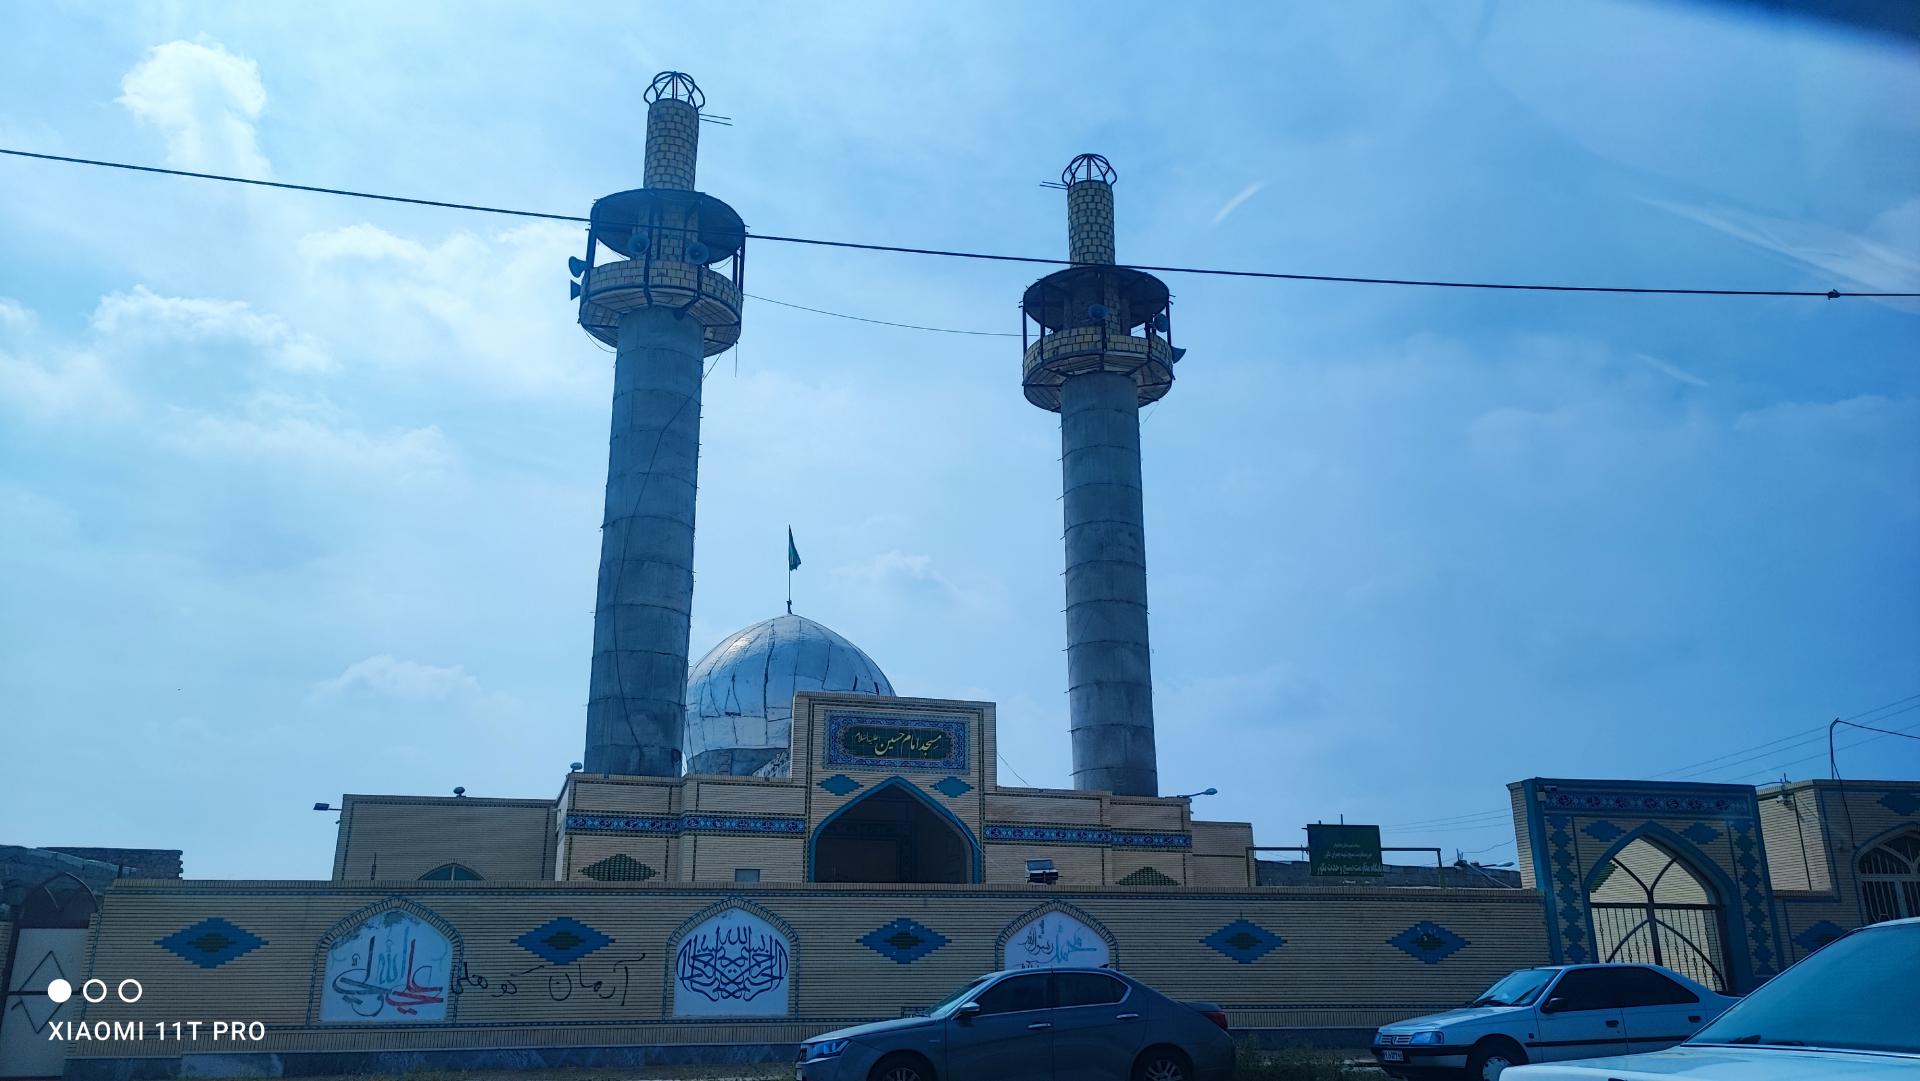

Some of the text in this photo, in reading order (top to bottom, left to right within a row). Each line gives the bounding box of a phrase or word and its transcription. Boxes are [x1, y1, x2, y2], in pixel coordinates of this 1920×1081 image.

[874, 732, 905, 756] حسین
[901, 733, 919, 756] امام
[918, 734, 942, 756] مسجد
[548, 952, 646, 1006] آرمان
